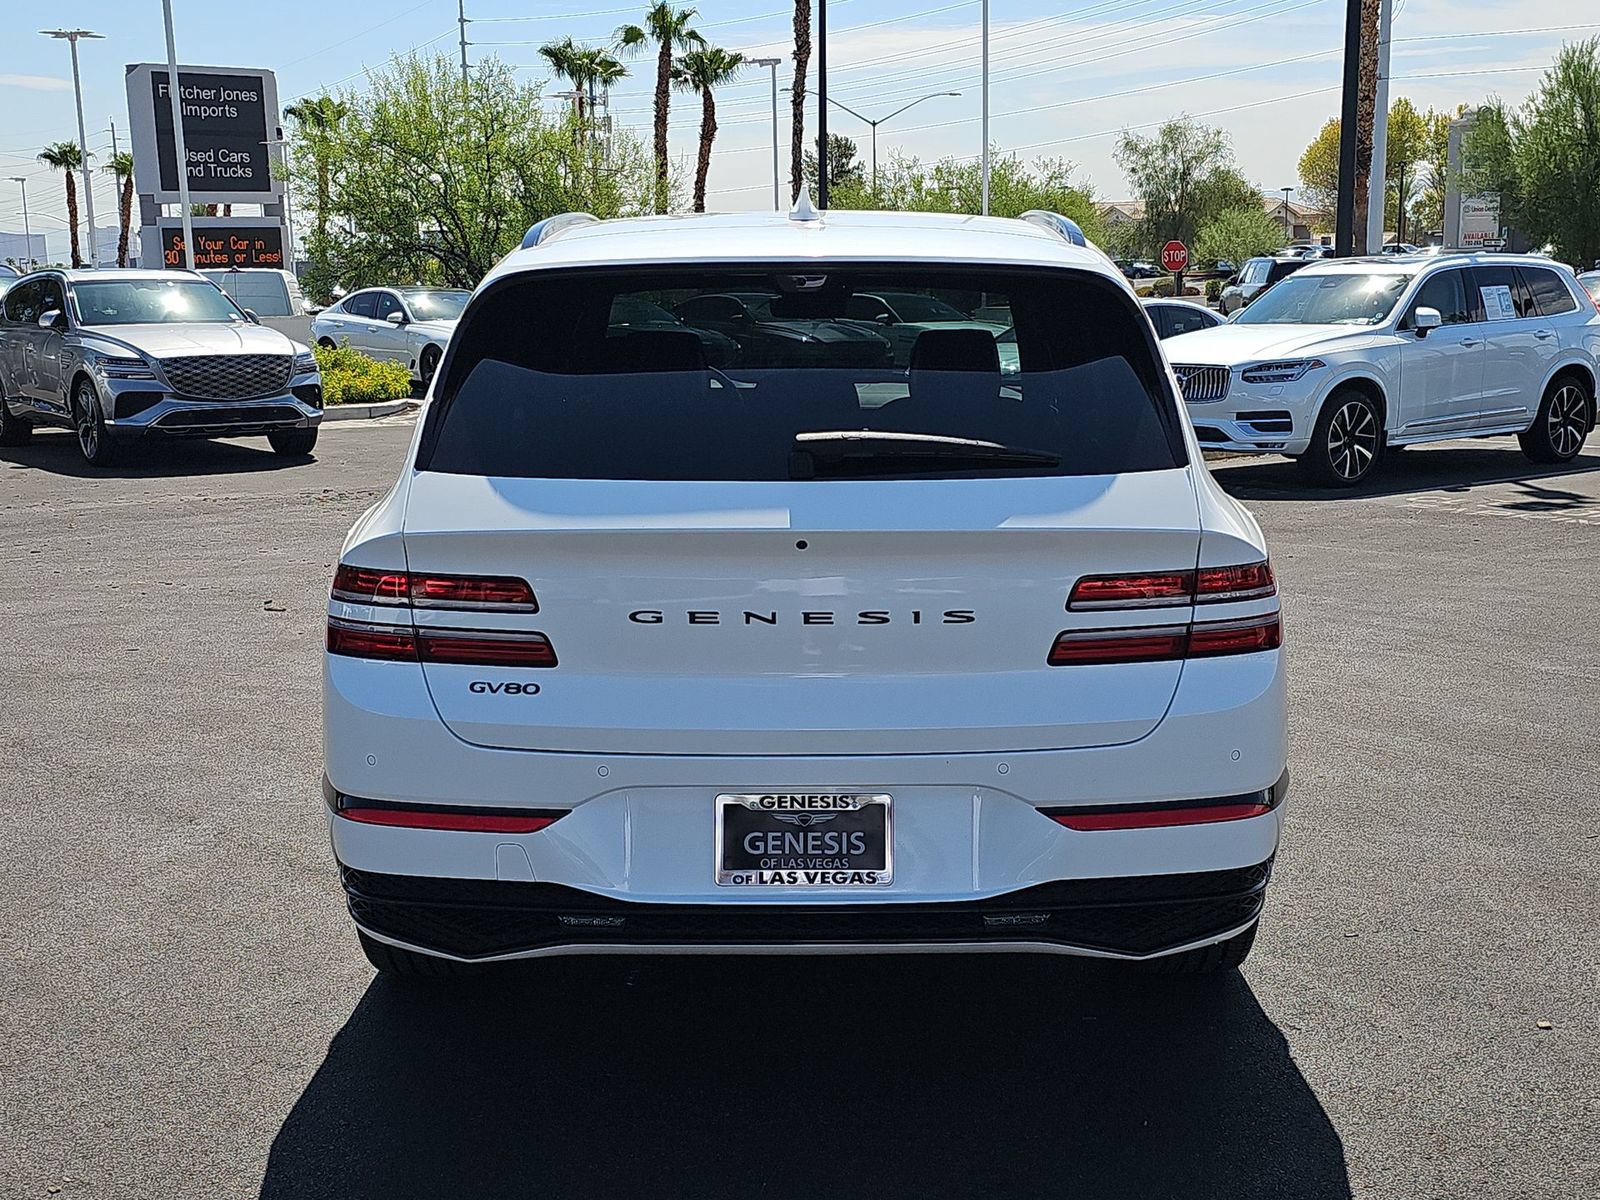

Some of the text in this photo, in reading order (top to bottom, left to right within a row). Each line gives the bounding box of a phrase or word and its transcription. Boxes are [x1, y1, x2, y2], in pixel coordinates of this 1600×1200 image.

[158, 83, 258, 102] Fltcher Jones
[182, 101, 238, 119] Imports
[218, 149, 251, 164] Cars
[187, 163, 253, 178] nd Trucks
[173, 236, 265, 250] Se Your Car in
[1463, 232, 1495, 240] AVAILABLE
[165, 249, 282, 264] 30 inutes or Less!
[1163, 250, 1186, 262] STOP
[628, 610, 976, 625] GENESIS
[469, 681, 541, 695] GV80
[758, 795, 850, 809] GENESIS
[743, 831, 866, 855] GENESIS
[760, 857, 849, 869] OF LAS VEGAS
[732, 871, 877, 885] OF LAS VEGAS
